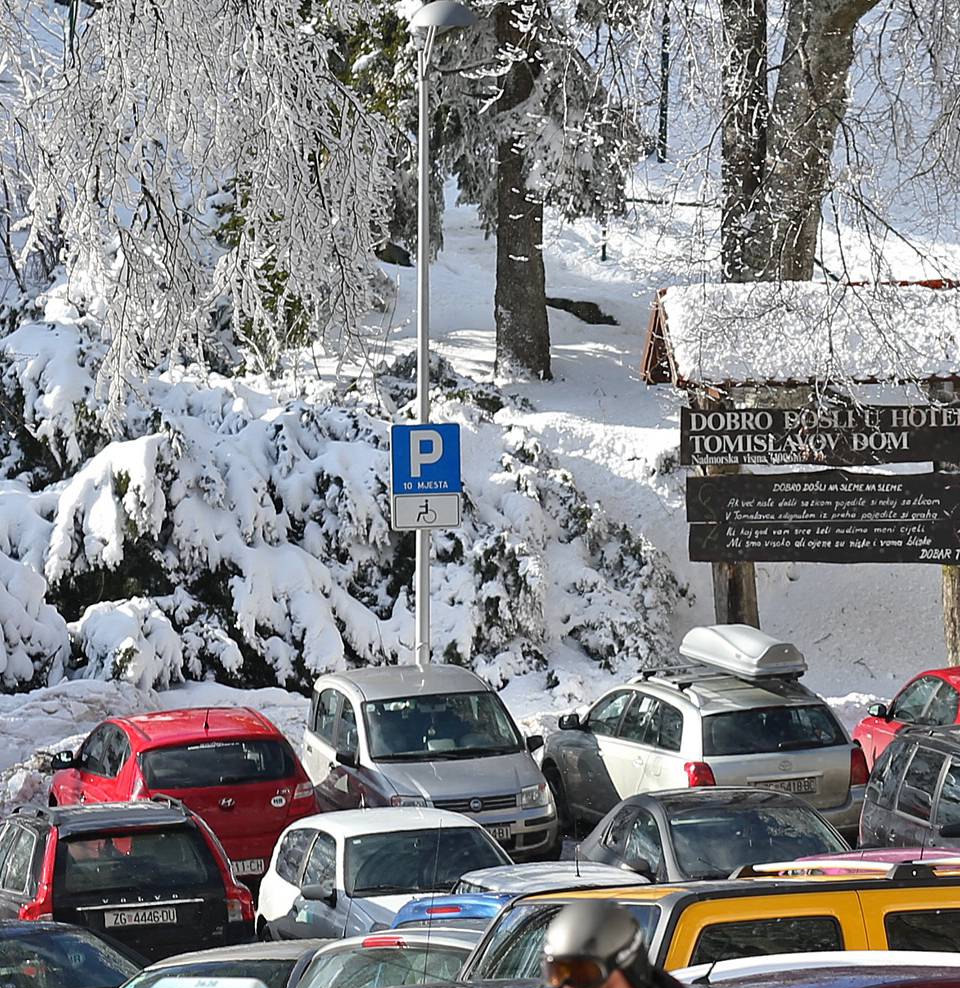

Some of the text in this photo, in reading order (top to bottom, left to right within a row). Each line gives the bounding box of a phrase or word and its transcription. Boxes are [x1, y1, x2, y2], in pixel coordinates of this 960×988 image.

[689, 411, 774, 432] DOBRO
[689, 431, 910, 454] TOMISLAVOV DOM
[409, 429, 443, 478] P
[690, 452, 740, 466] Nadmorska
[403, 480, 449, 491] 10 MJESTA
[772, 480, 904, 493] DOBRO DOŠLI NA SLEME NA SLEME
[725, 511, 732, 521] V
[919, 548, 952, 560] DOBAR
[113, 911, 127, 926] ZG
